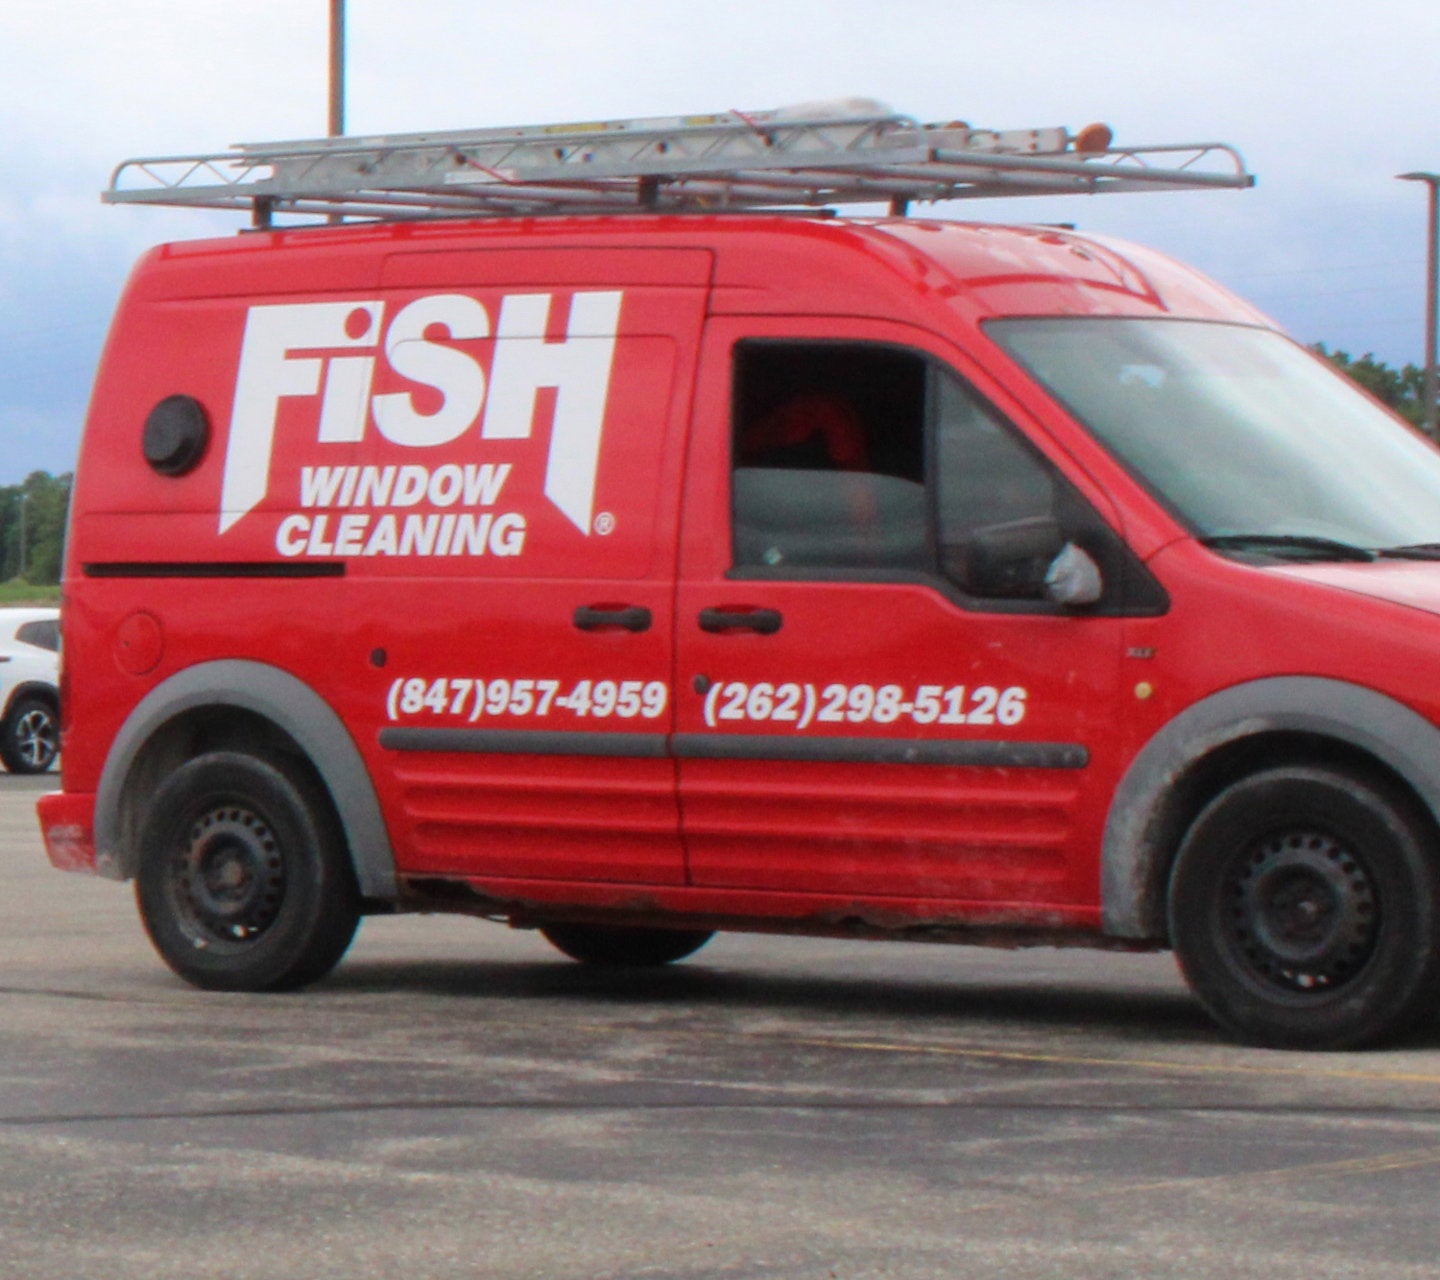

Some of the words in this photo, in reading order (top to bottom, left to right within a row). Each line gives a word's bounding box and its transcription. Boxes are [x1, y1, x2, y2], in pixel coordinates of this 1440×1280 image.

[300, 464, 512, 508] WINDOW
[275, 514, 526, 557] CLEANING
[386, 678, 667, 720] (847)957-4959
[703, 682, 1026, 728] (262)298-5126
